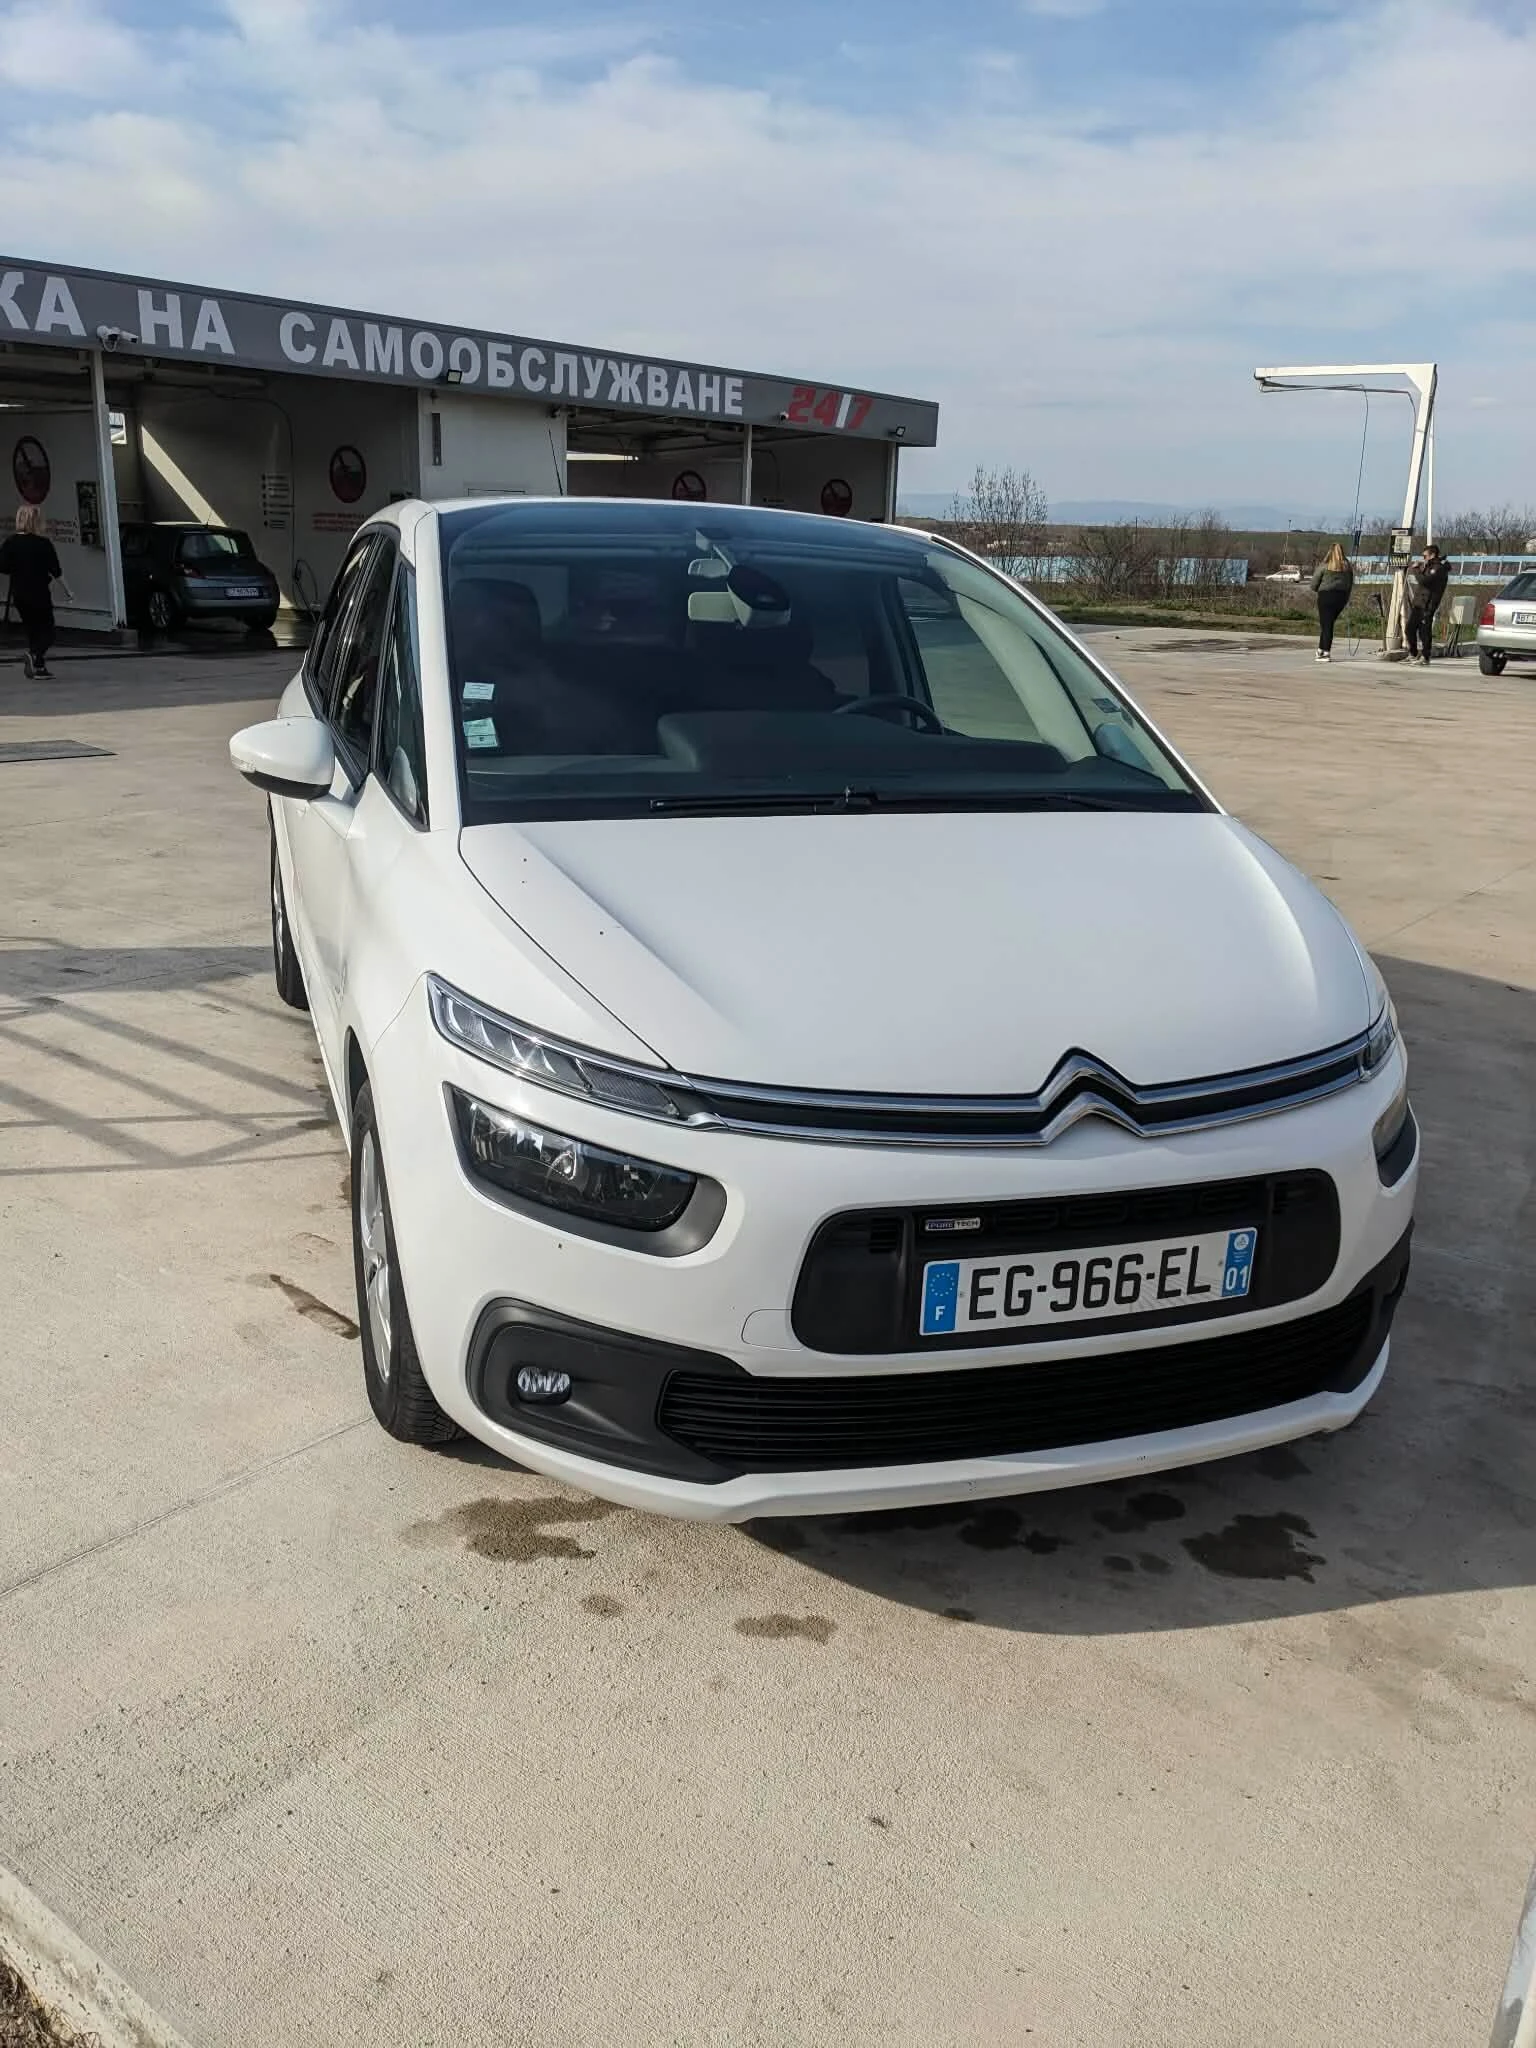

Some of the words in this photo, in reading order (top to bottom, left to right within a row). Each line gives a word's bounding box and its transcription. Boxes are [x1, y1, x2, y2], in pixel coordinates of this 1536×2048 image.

[138, 289, 235, 354] НА
[279, 311, 744, 416] САМООБСЛУЖВАНЕ
[788, 385, 873, 430] 24/7
[935, 1305, 946, 1321] F
[968, 1245, 1211, 1321] EG-966-EL
[1226, 1265, 1248, 1290] 01
